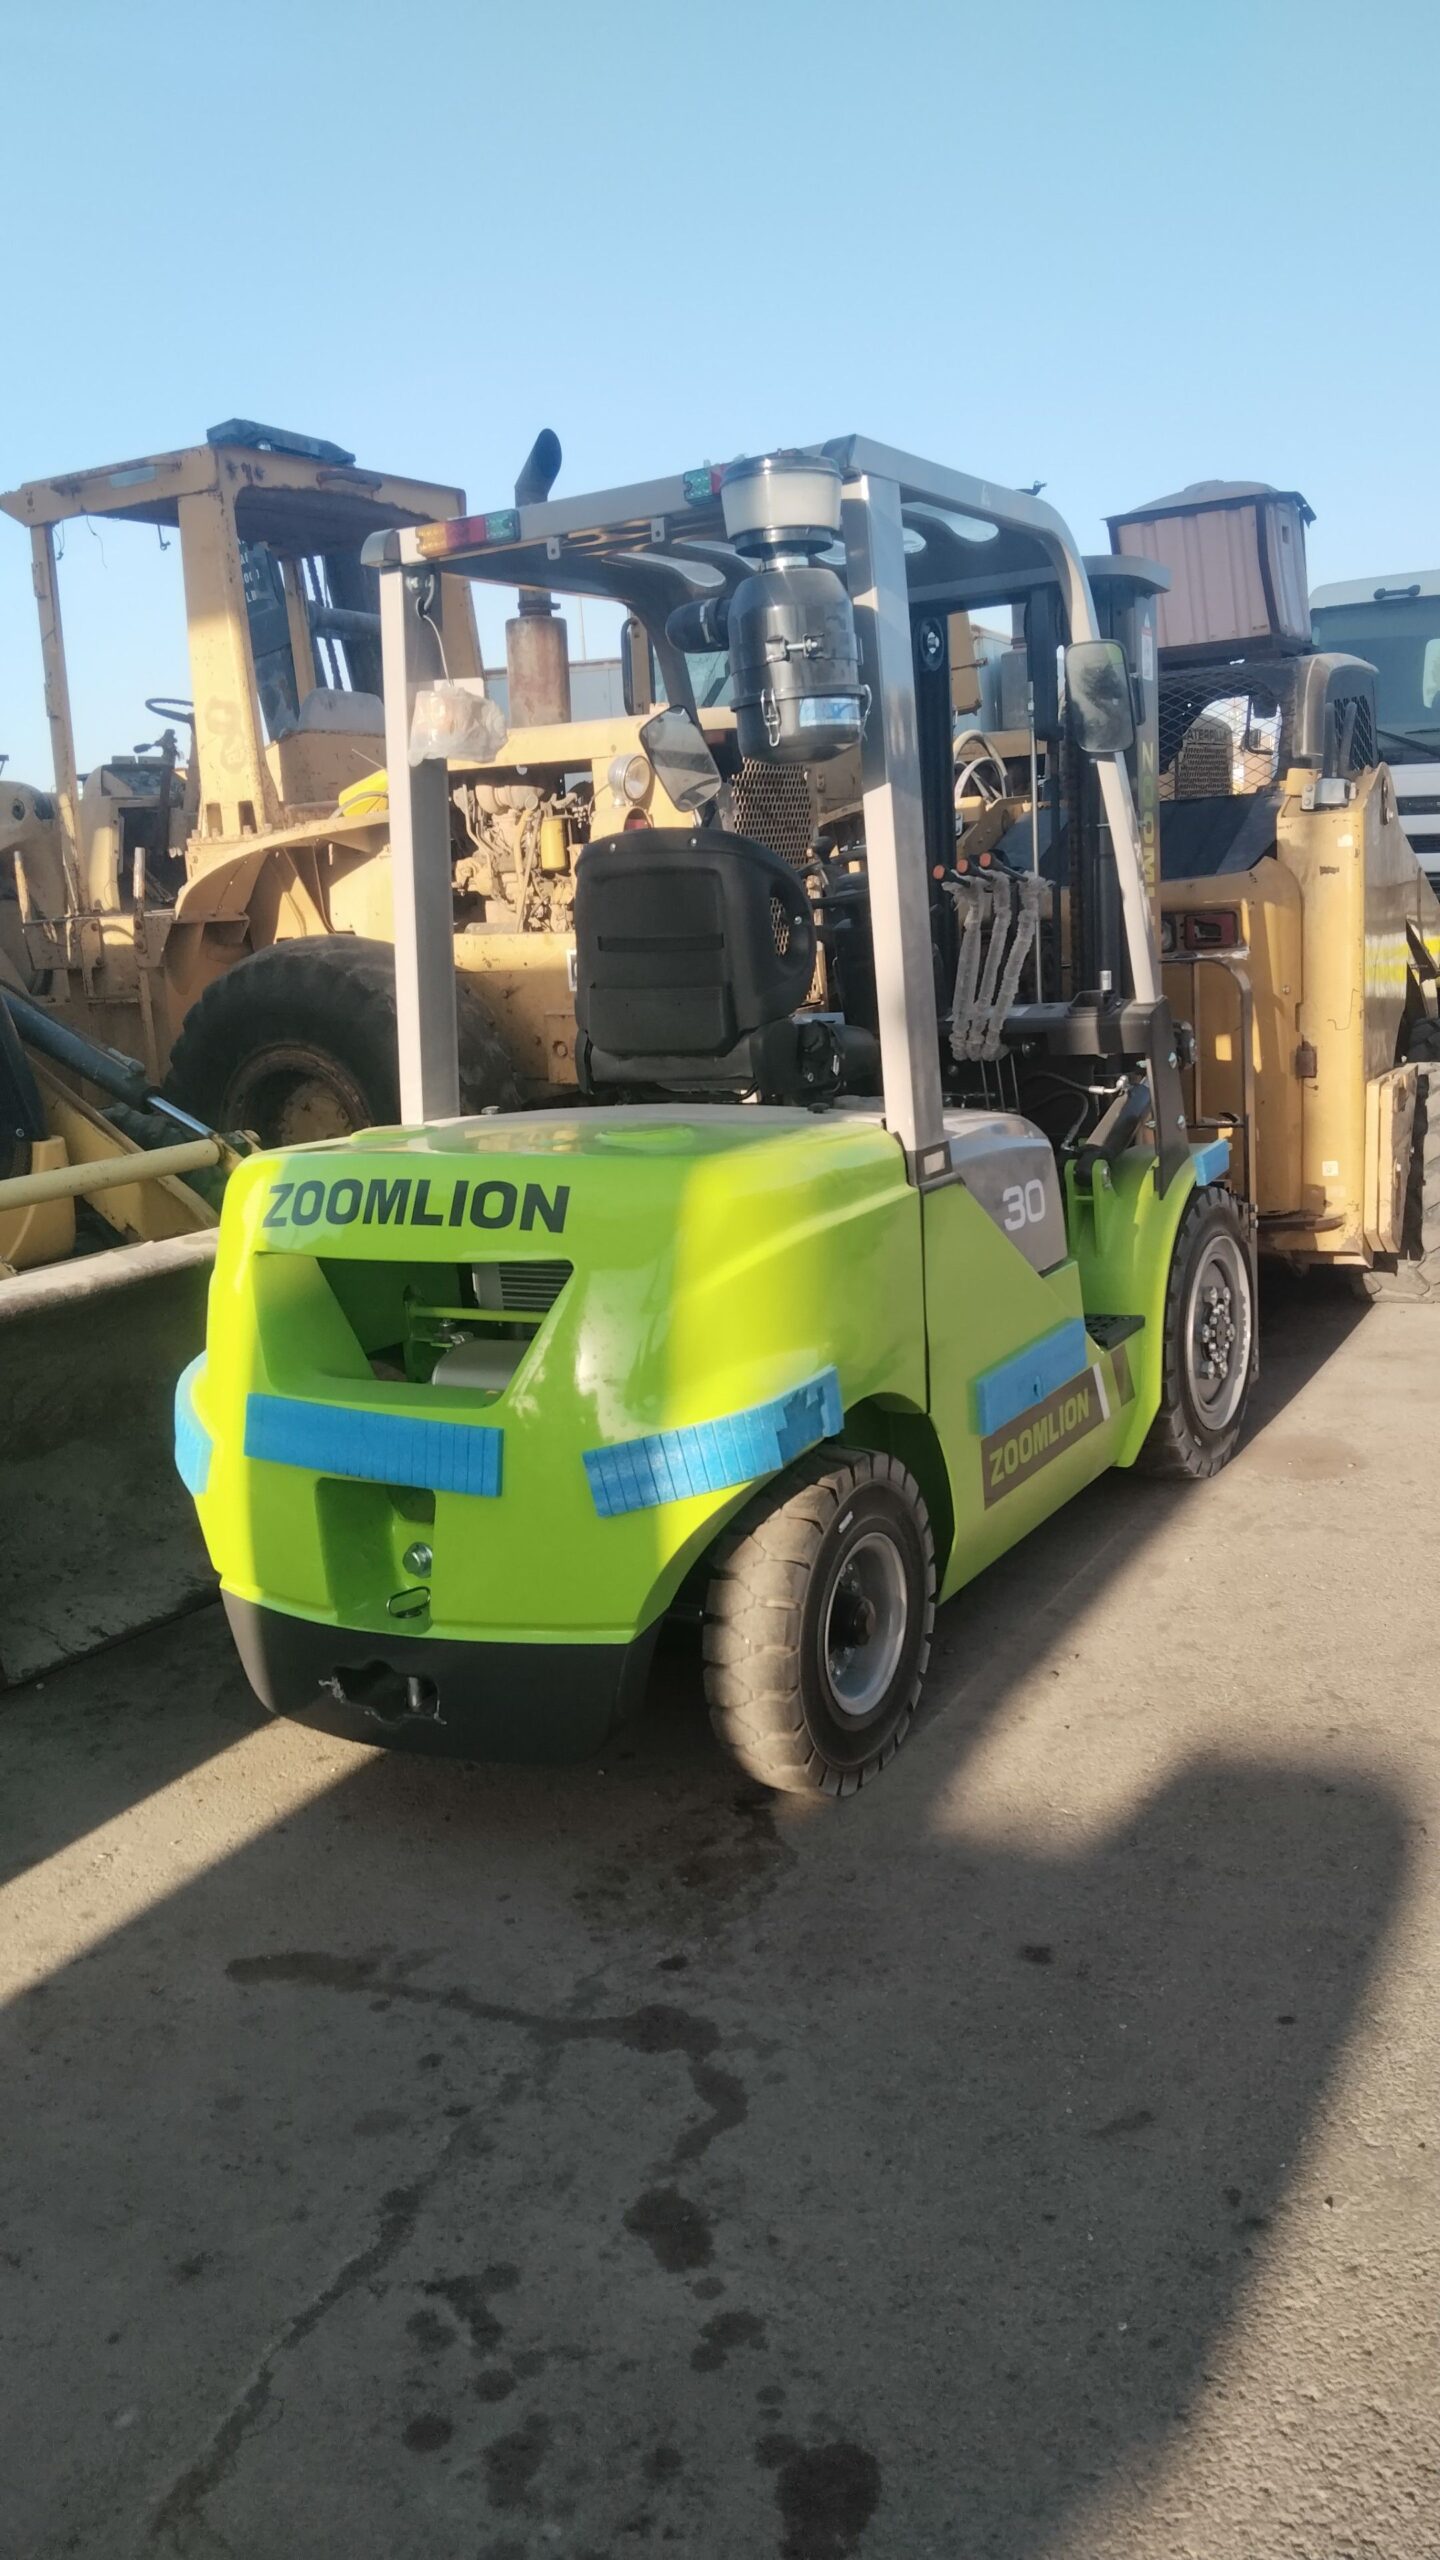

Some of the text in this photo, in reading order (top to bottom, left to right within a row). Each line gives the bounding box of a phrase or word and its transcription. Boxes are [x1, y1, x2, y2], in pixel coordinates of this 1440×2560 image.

[262, 1178, 571, 1234] ZOOMLION
[1002, 1178, 1046, 1231] 30
[989, 1387, 1090, 1488] ZOOMLION
